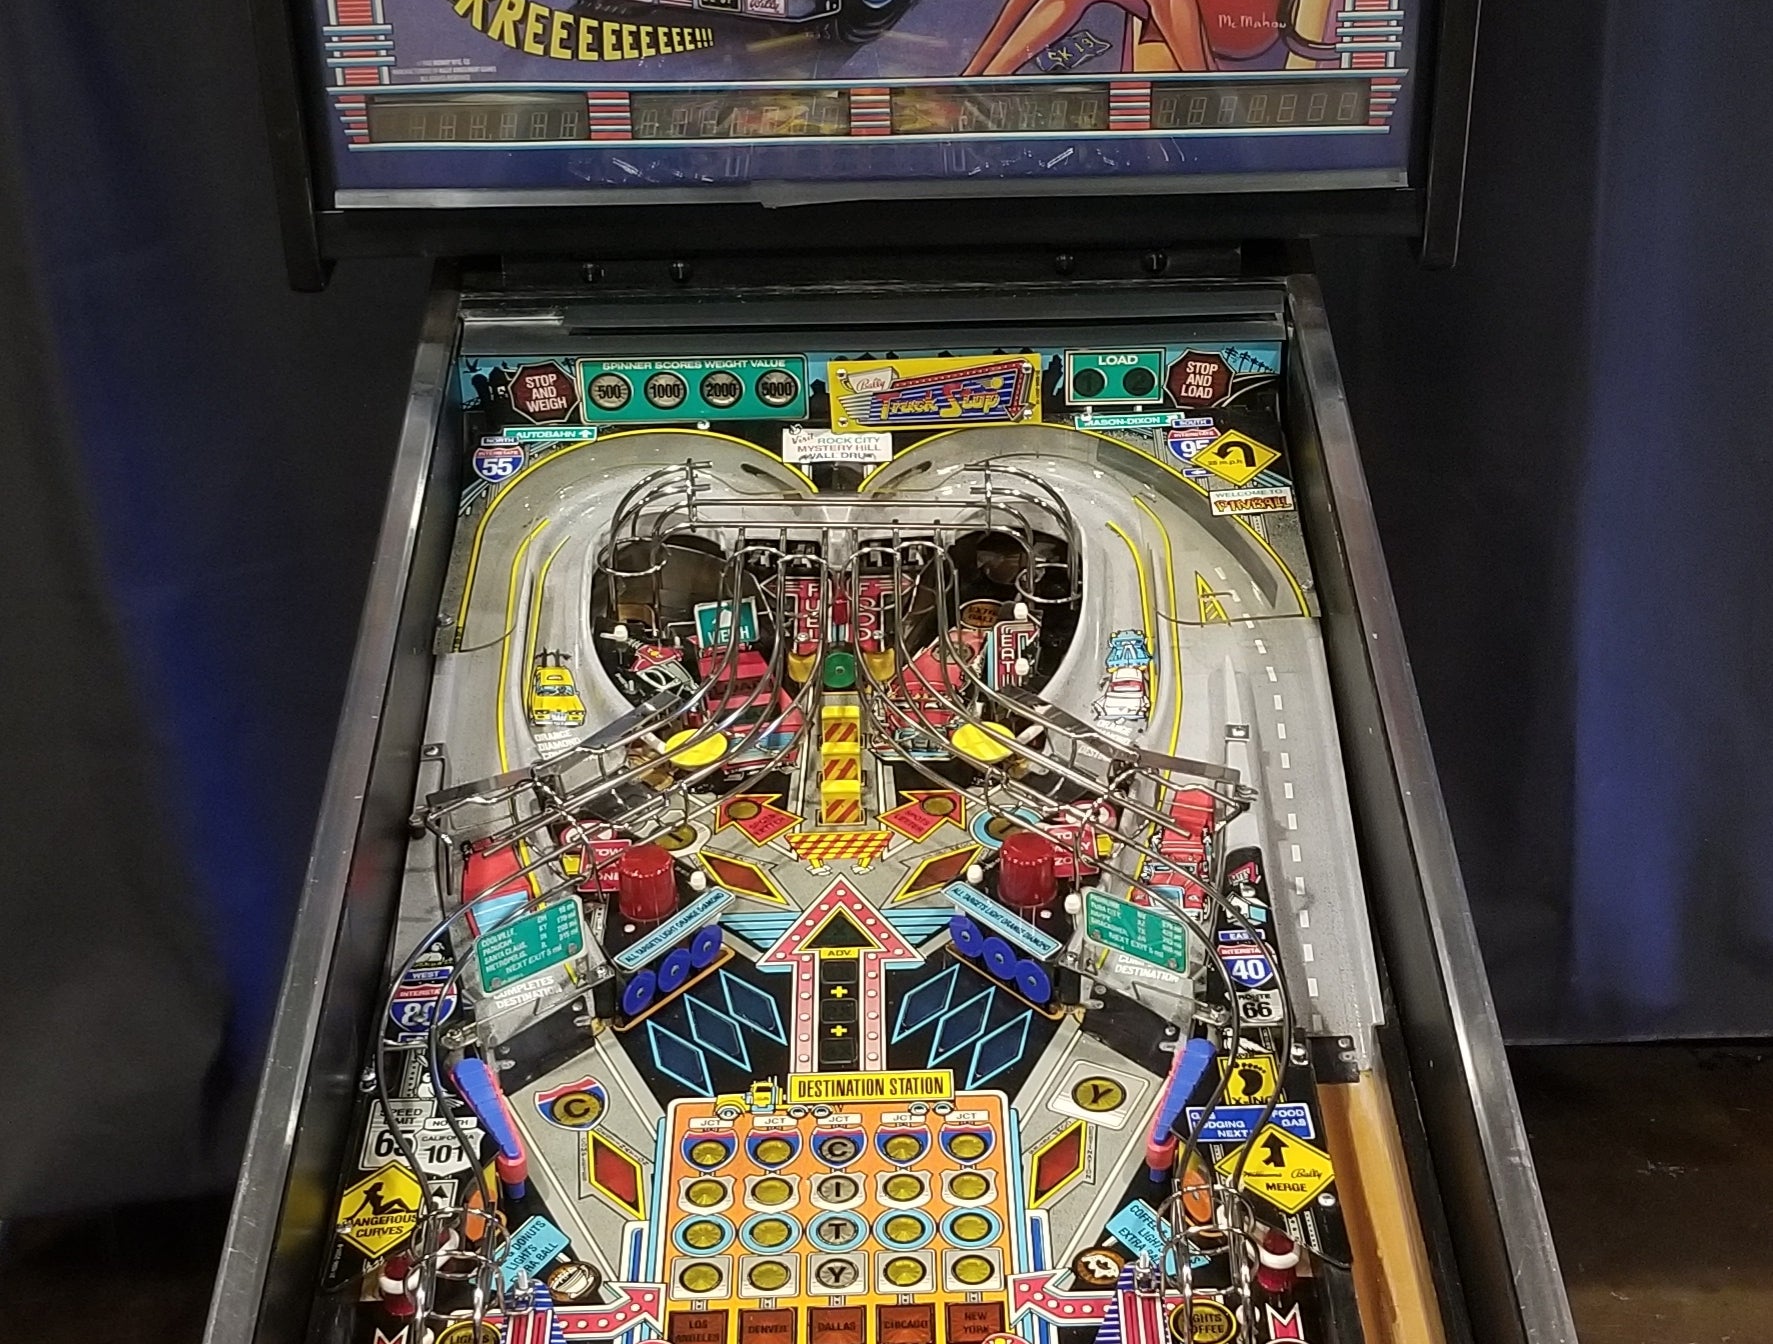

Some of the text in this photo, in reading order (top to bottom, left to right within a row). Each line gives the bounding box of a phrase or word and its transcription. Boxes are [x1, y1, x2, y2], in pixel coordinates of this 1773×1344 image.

[602, 359, 786, 370] SPINNER SCORES WEIGHT VALUE
[1098, 355, 1139, 366] LOAD
[1186, 361, 1219, 375] STOP
[525, 374, 557, 389] STOP
[856, 377, 886, 391] Bally
[1185, 373, 1212, 387] AND
[532, 386, 557, 400] AND
[598, 384, 622, 399] 500
[651, 383, 680, 399] 1000
[706, 383, 737, 397] 2000
[762, 381, 792, 396] 5000
[1180, 384, 1213, 399] LOAD
[526, 397, 568, 413] WEIGH
[873, 382, 1000, 421] Truck Stop
[1084, 416, 1161, 427] MASON-DIXON
[516, 430, 577, 439] AUTOBAHN
[791, 432, 815, 445] Visit
[854, 436, 880, 444] CITY
[797, 445, 853, 453] MYSTERY
[1180, 439, 1210, 458] 95
[482, 457, 513, 477] 55
[1215, 488, 1284, 498] WELCOME TO
[1213, 495, 1293, 513] PINBALL
[708, 627, 750, 645] WEH
[1001, 634, 1014, 672] EAT
[827, 949, 853, 957] ADV.
[505, 950, 547, 974] NEXT EXIT
[412, 970, 441, 979] WEST
[1114, 964, 1180, 983] DESTINATION
[1232, 959, 1266, 980] 40
[1237, 992, 1271, 1001] ROUTE
[1241, 1002, 1272, 1019] 66
[798, 1075, 944, 1099] DESTINATION STATION
[1090, 1086, 1115, 1102] Y
[564, 1098, 591, 1118] C
[1271, 1109, 1304, 1118] FOOD
[764, 1117, 786, 1125] JCT
[828, 1115, 850, 1123] JCT
[892, 1113, 914, 1122] JCT
[956, 1111, 978, 1120] JCT
[1281, 1118, 1307, 1127] GAS
[700, 1119, 721, 1127] JCT
[1217, 1129, 1249, 1138] NEXT
[423, 1144, 464, 1164] 101
[826, 1142, 847, 1157] C
[1265, 1182, 1308, 1193] MERGE
[342, 1213, 417, 1227] DANGEROUS
[355, 1225, 404, 1238] CURVES
[511, 1220, 547, 1251] DONUTS
[829, 1222, 847, 1240] T
[1118, 1226, 1145, 1251] EXTRA
[506, 1243, 538, 1271] LIGHTS
[536, 1242, 559, 1262] BALL
[827, 1265, 846, 1284] Y
[964, 1312, 988, 1320] NEW
[688, 1319, 708, 1329] LOS
[748, 1325, 788, 1334] DENVER
[817, 1321, 856, 1331] DALLAS
[883, 1320, 928, 1330] CHICAGO
[962, 1325, 989, 1334] YORK
